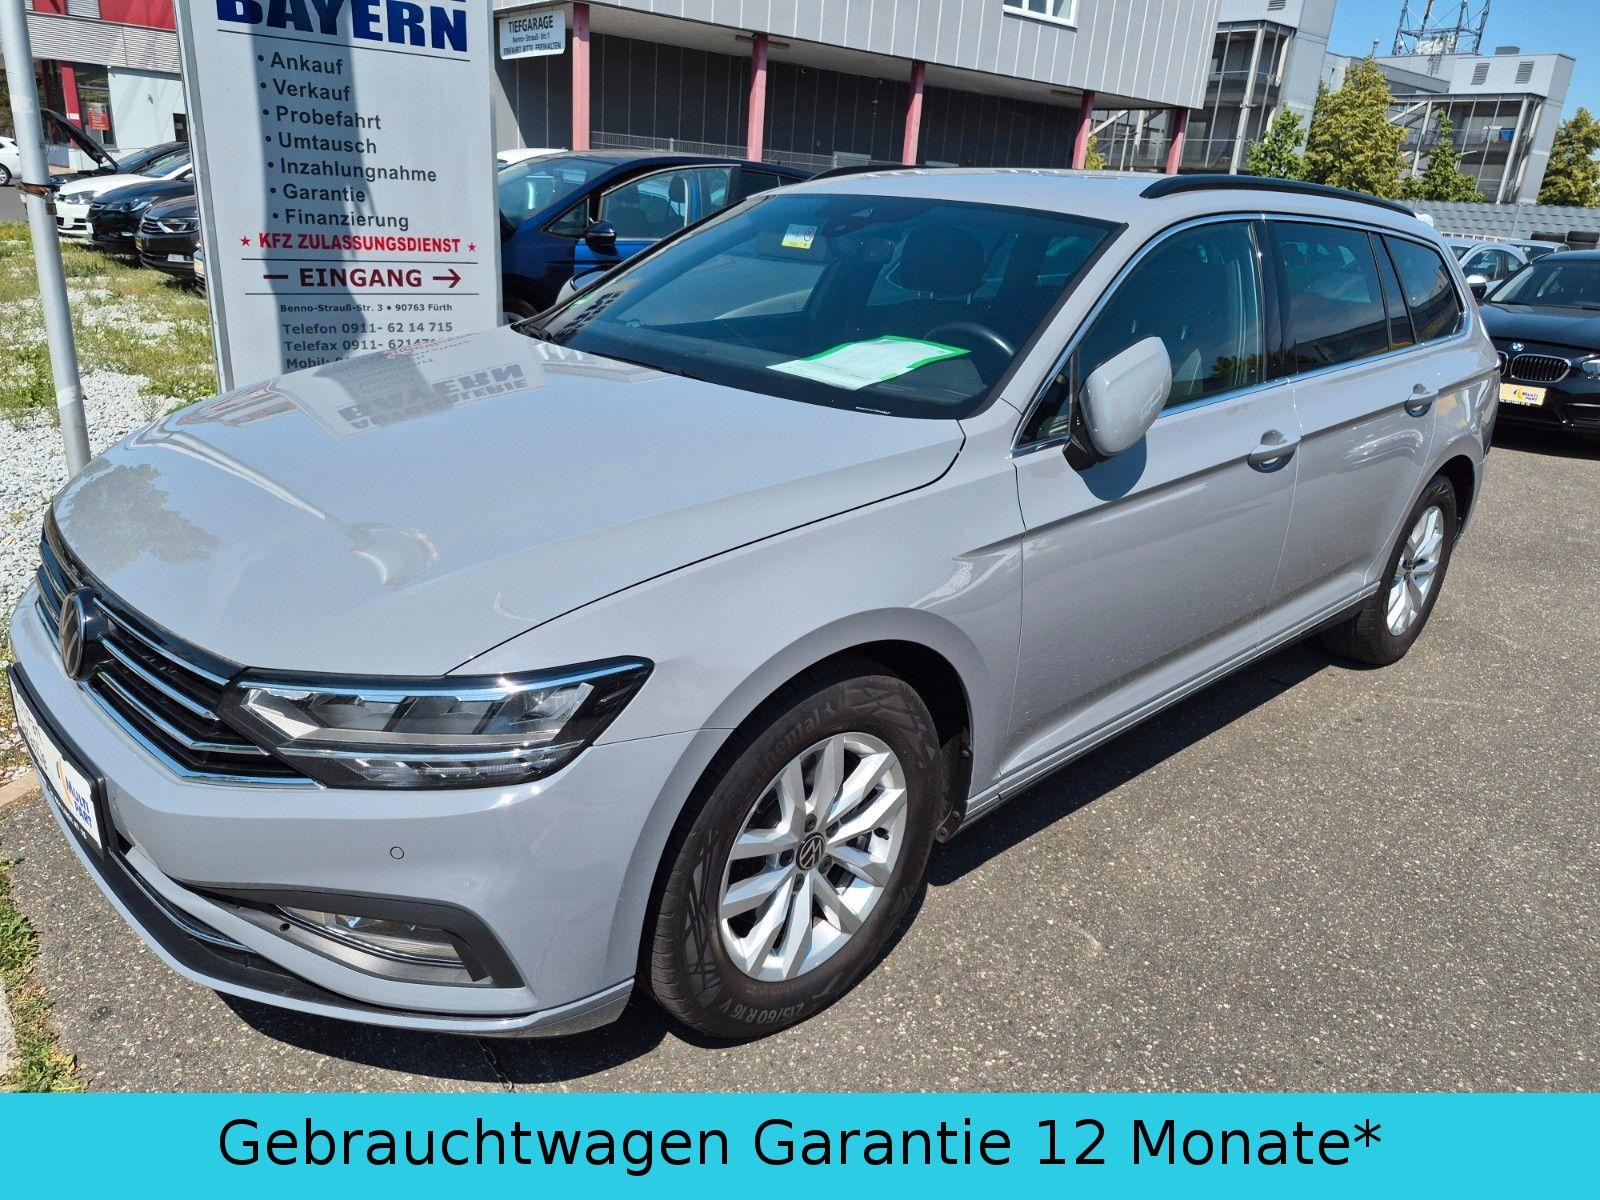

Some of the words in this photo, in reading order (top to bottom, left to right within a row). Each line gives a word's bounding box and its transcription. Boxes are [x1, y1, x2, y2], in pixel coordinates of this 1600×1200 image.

[216, 0, 467, 52] BAYERN
[508, 15, 553, 34] TIEFGARAGE
[270, 51, 343, 75] Ankauf
[273, 78, 350, 101] Verkauf
[276, 105, 381, 129] Probefahrt
[278, 131, 377, 154] Umtausch
[280, 157, 437, 182] Inzahlungnahme
[283, 183, 366, 202] Garantie
[285, 208, 409, 232] Finanzierung
[258, 232, 293, 249] KFZ
[297, 233, 461, 253] ZULASSUNGSDIENST
[299, 268, 423, 288] EINGANG
[377, 304, 383, 312] 3
[395, 303, 425, 312] 90763
[428, 303, 453, 312] Fürth
[282, 322, 337, 335] Telefon
[341, 322, 383, 334] 0911-
[387, 322, 404, 333] 62
[408, 322, 425, 333] 14
[429, 322, 453, 332] 715
[284, 340, 337, 352] Telefax
[342, 340, 383, 350] 0911-
